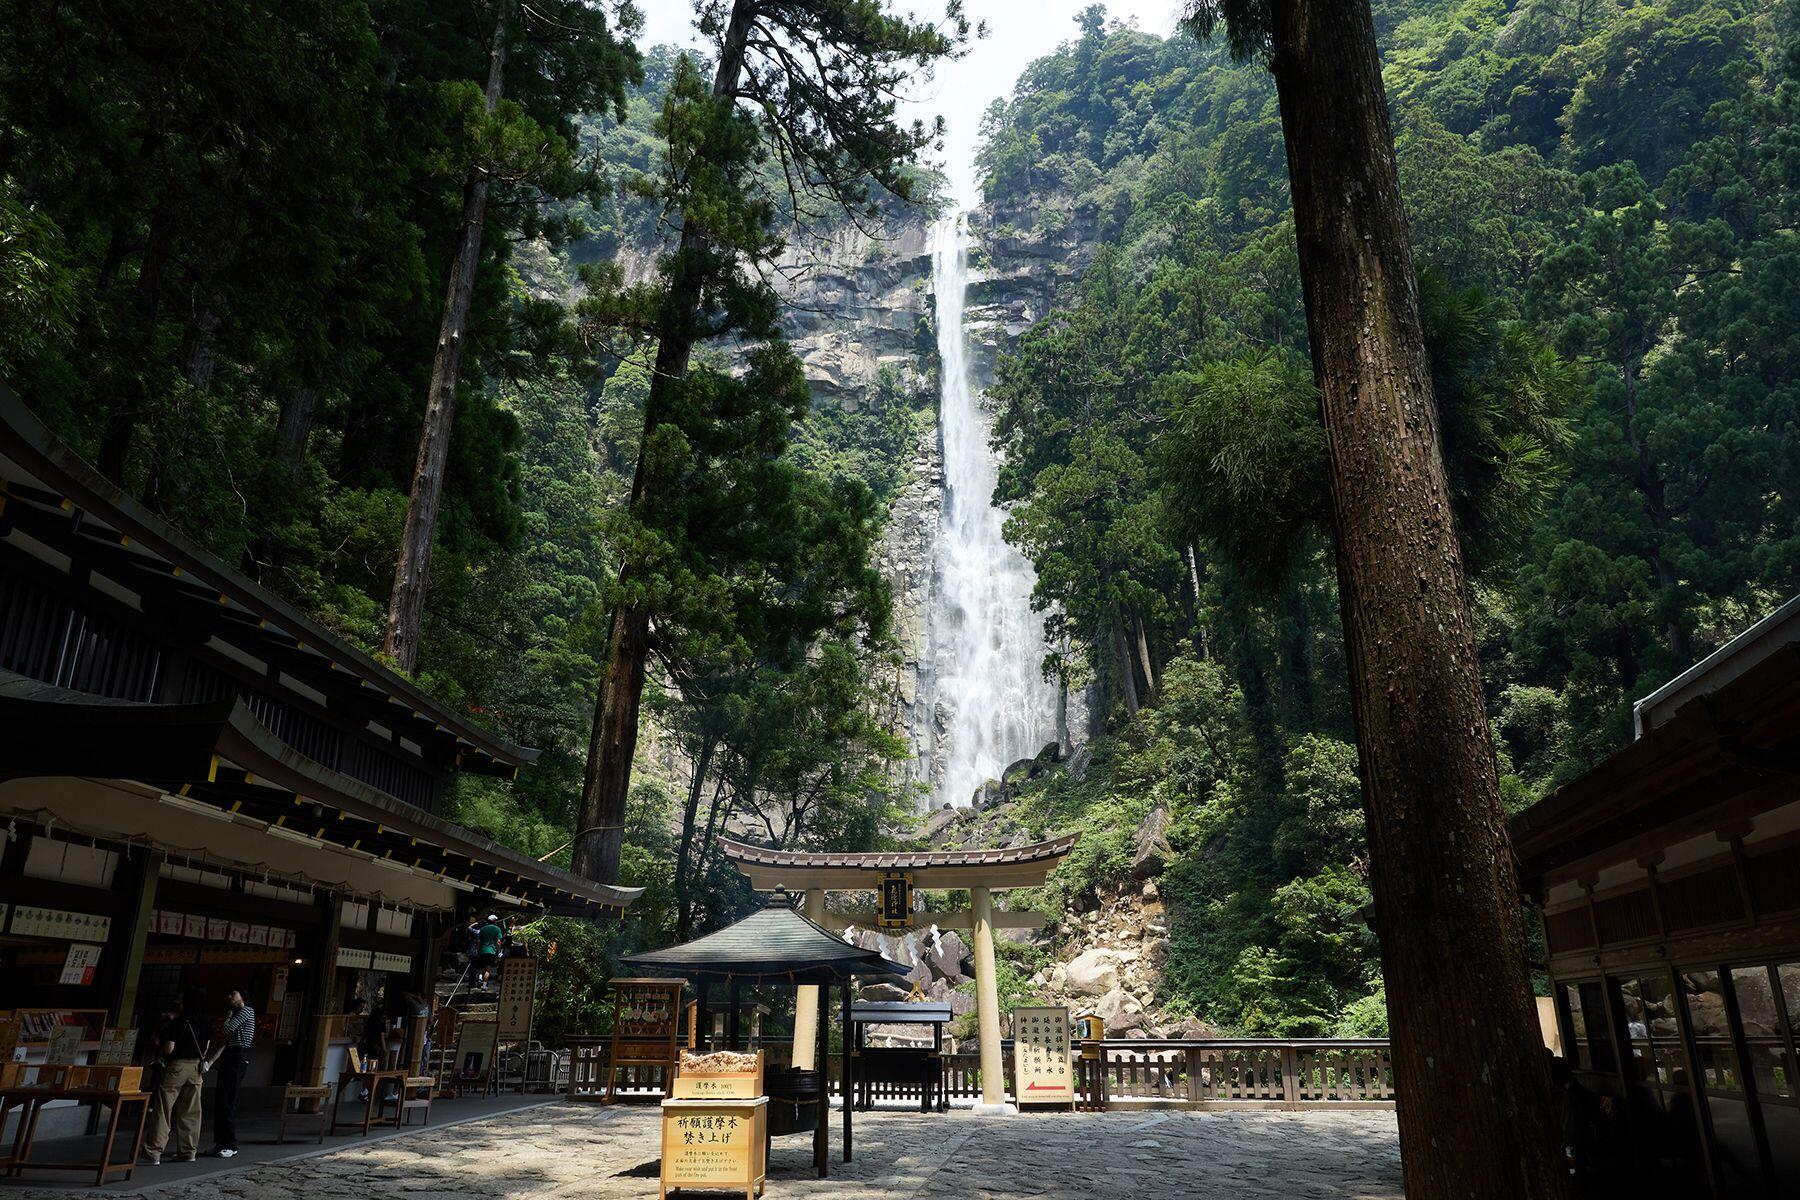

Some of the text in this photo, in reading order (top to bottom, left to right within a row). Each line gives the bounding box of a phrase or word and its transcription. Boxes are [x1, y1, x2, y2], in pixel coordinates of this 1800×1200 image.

[677, 1116, 738, 1130] 祈願護摩木
[684, 1131, 732, 1145] 焚き上げ
